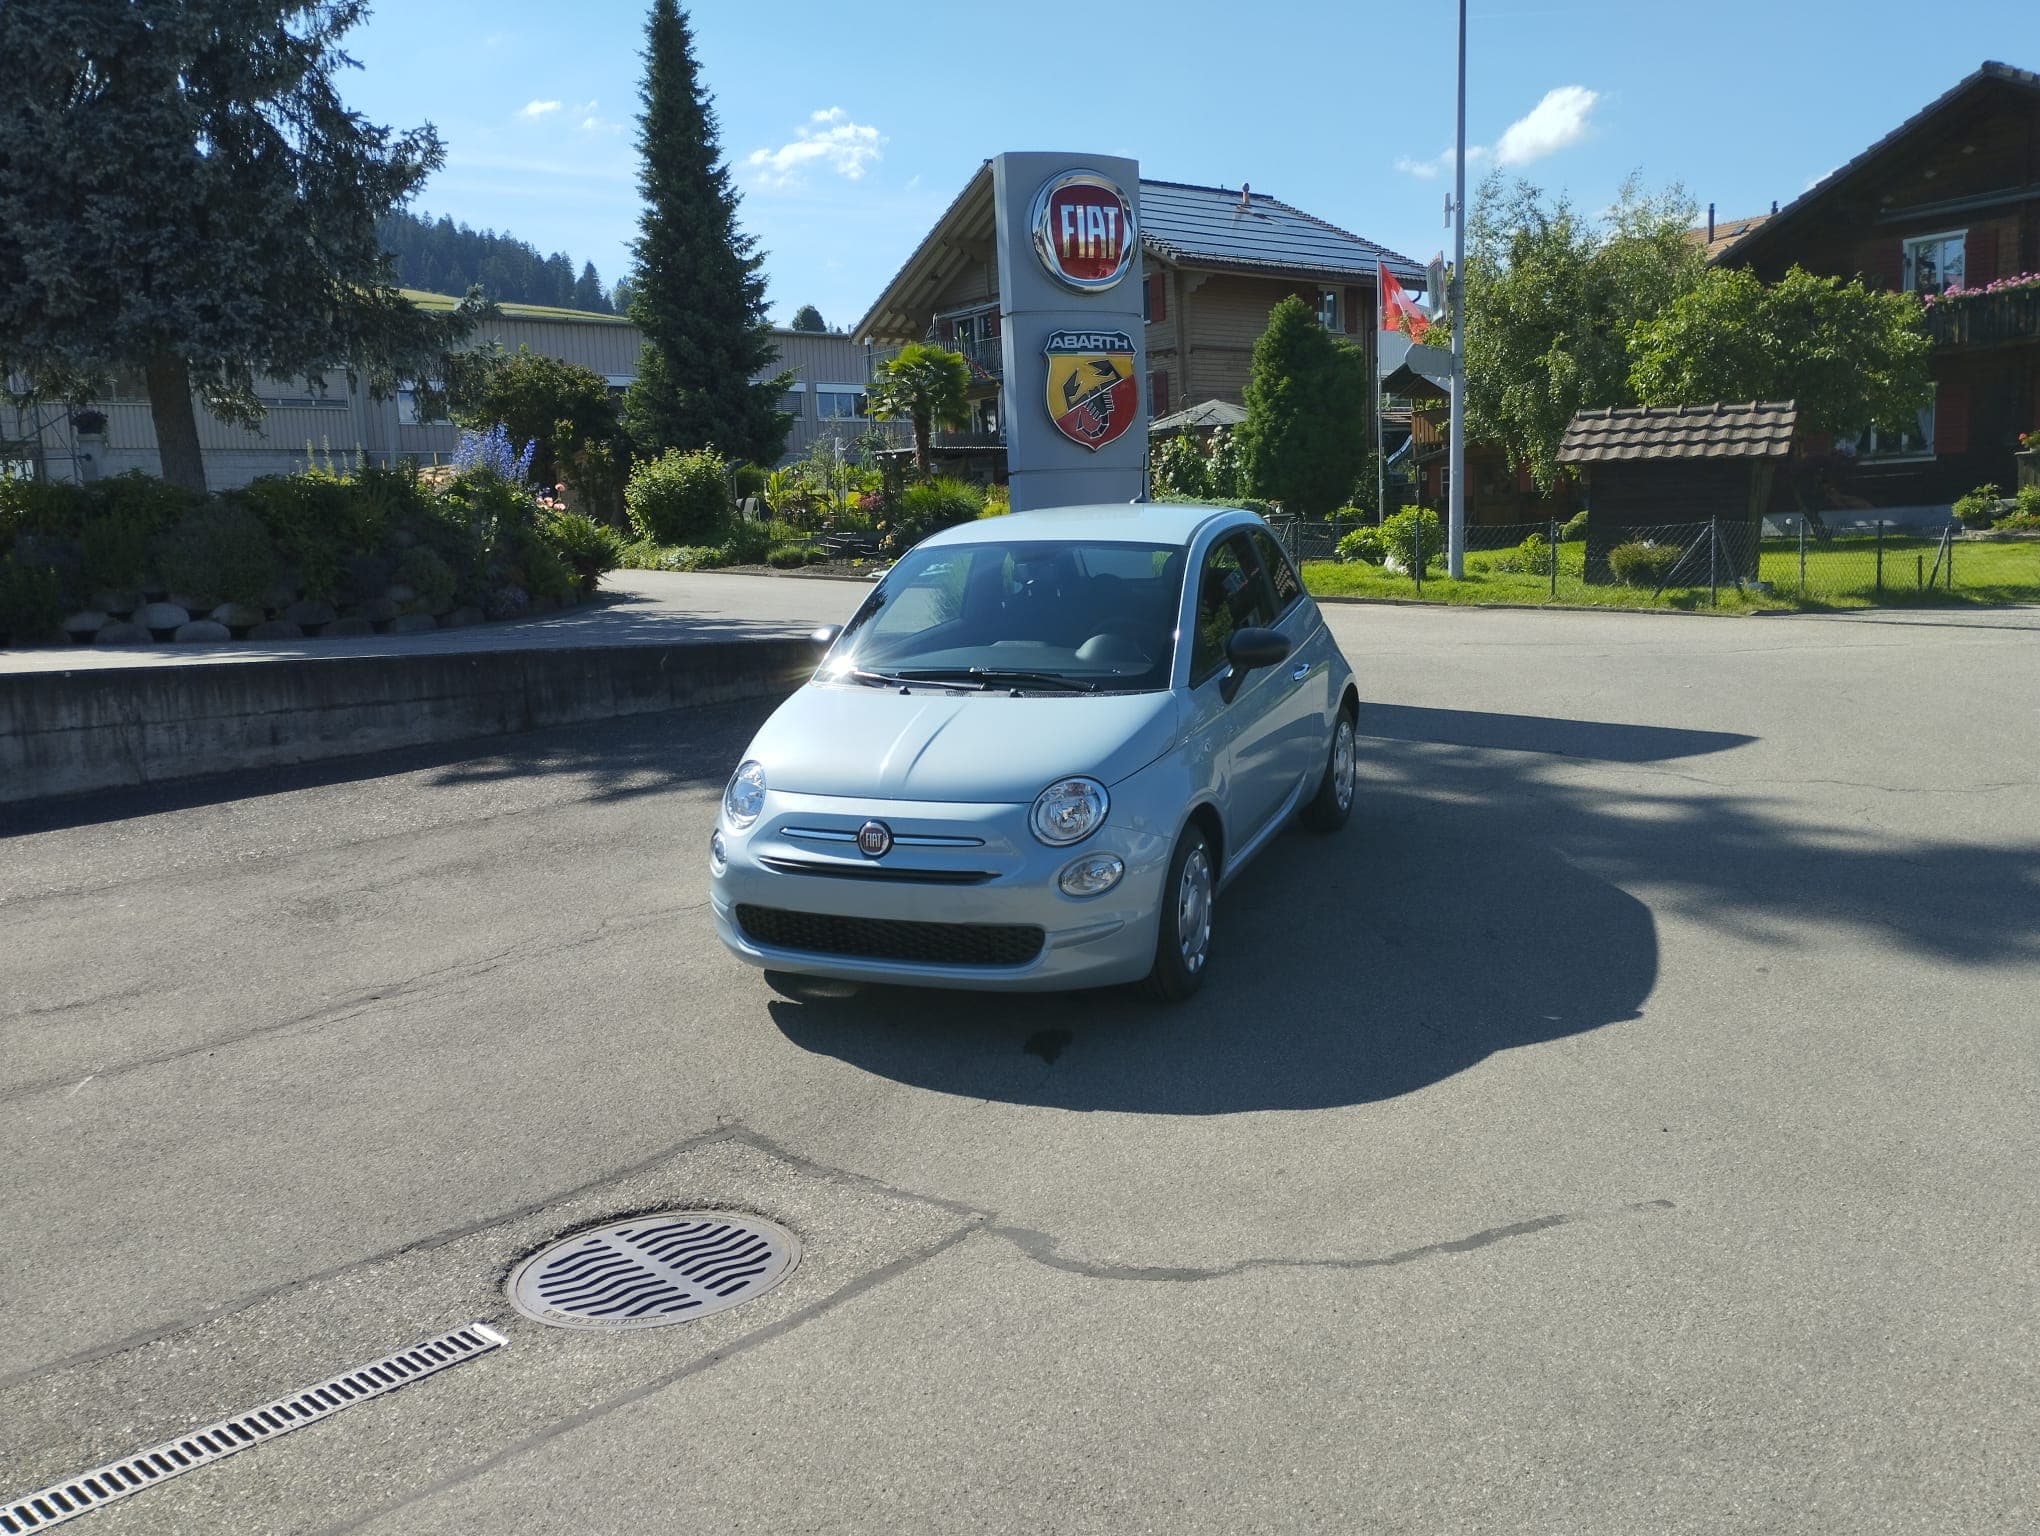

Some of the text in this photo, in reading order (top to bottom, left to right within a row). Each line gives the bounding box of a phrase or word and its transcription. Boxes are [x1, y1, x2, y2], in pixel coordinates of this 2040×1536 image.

[1060, 204, 1119, 259] FIAT
[1050, 335, 1128, 349] ABARTH
[865, 832, 882, 848] FIAT
